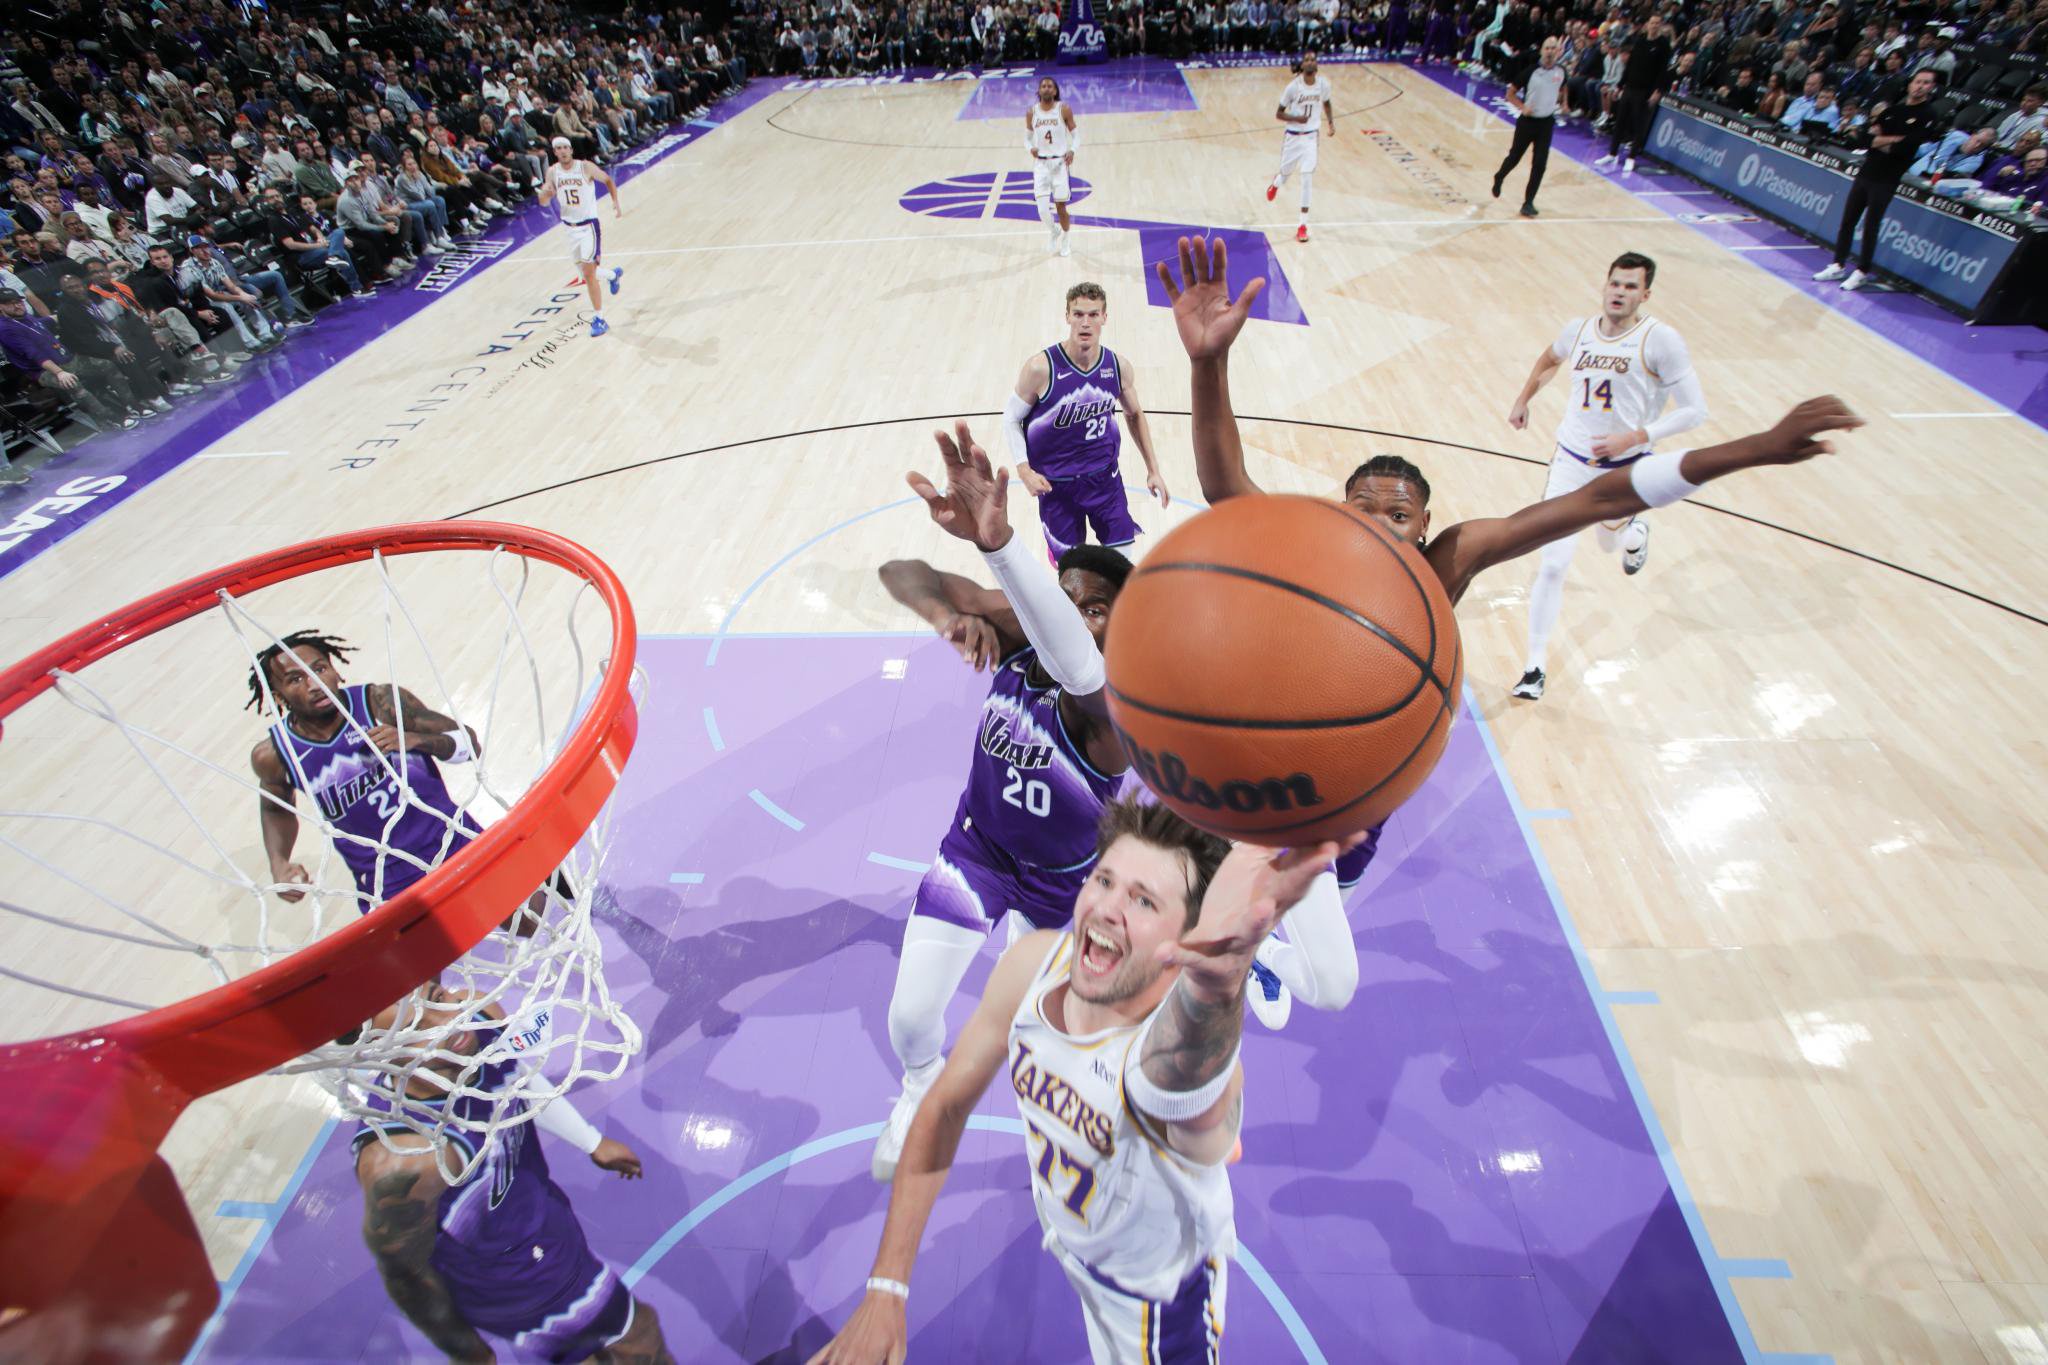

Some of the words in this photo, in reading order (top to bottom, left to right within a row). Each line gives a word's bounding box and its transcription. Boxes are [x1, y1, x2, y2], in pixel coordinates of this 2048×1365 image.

[782, 75, 905, 91] UTAH
[914, 68, 1036, 84] JAZZ
[1044, 129, 1053, 144] 4
[1670, 128, 1728, 168] 1Password
[564, 189, 580, 205] 15
[1755, 164, 1833, 216] 1Password
[1933, 197, 1965, 216] DELTA
[1982, 214, 2017, 236] DELTA
[1878, 216, 1988, 284] 1Password
[476, 293, 582, 357] DELTA
[1574, 350, 1632, 374] LAKERS
[1582, 378, 1613, 411] 14
[328, 366, 487, 471] CENTER
[1053, 398, 1114, 429] UTAH
[1085, 416, 1107, 441] 23
[981, 706, 1056, 770] UTAH
[1002, 766, 1051, 818] 20
[1011, 1039, 1115, 1160] LAKERS
[1026, 1118, 1097, 1225] 77
